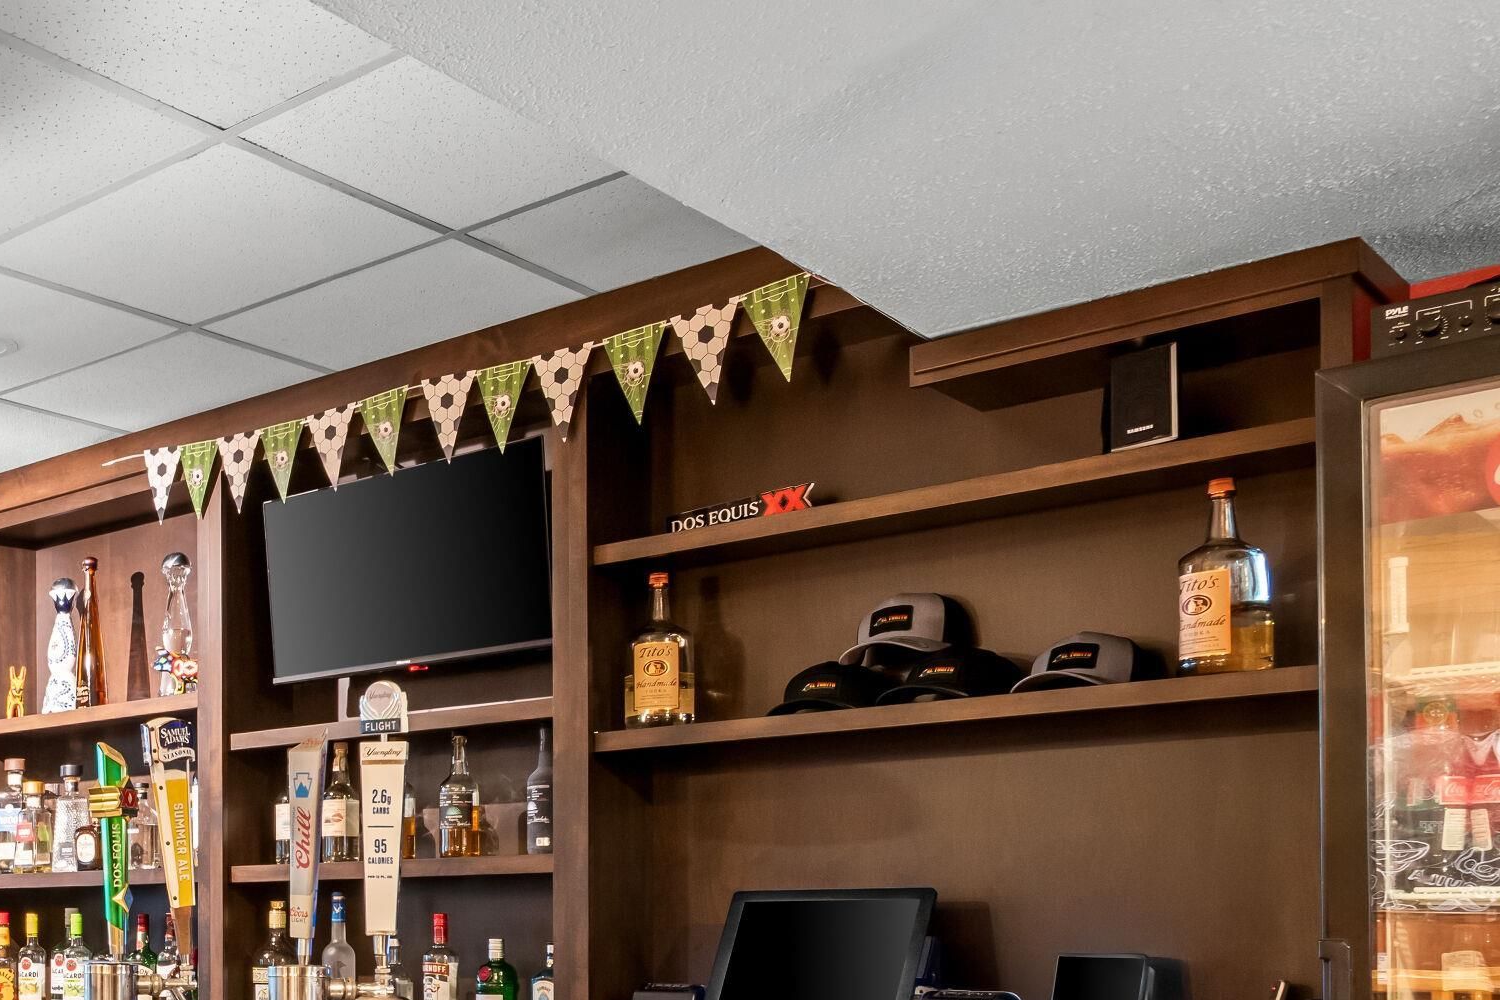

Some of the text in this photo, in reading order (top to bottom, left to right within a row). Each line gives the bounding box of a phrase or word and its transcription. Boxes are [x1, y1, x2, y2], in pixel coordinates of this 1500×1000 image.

[1385, 306, 1409, 316] PYLE
[671, 485, 811, 533] DOS EQUIS XX
[1180, 615, 1227, 631] andmade
[639, 645, 672, 658] Tito's
[365, 720, 397, 732] FLIGHT
[160, 726, 191, 741] SAMUEL
[164, 734, 190, 747] ADAMS
[363, 746, 403, 757] Yuengling
[372, 789, 392, 805] 2.6g
[372, 807, 390, 815] CARBS
[173, 803, 190, 881] SUMMER ALE
[295, 806, 311, 870] Chill
[374, 838, 387, 854] 95
[111, 823, 122, 888] DOS EQUIS
[368, 856, 394, 865] CALORIES
[290, 906, 309, 918] Coors
